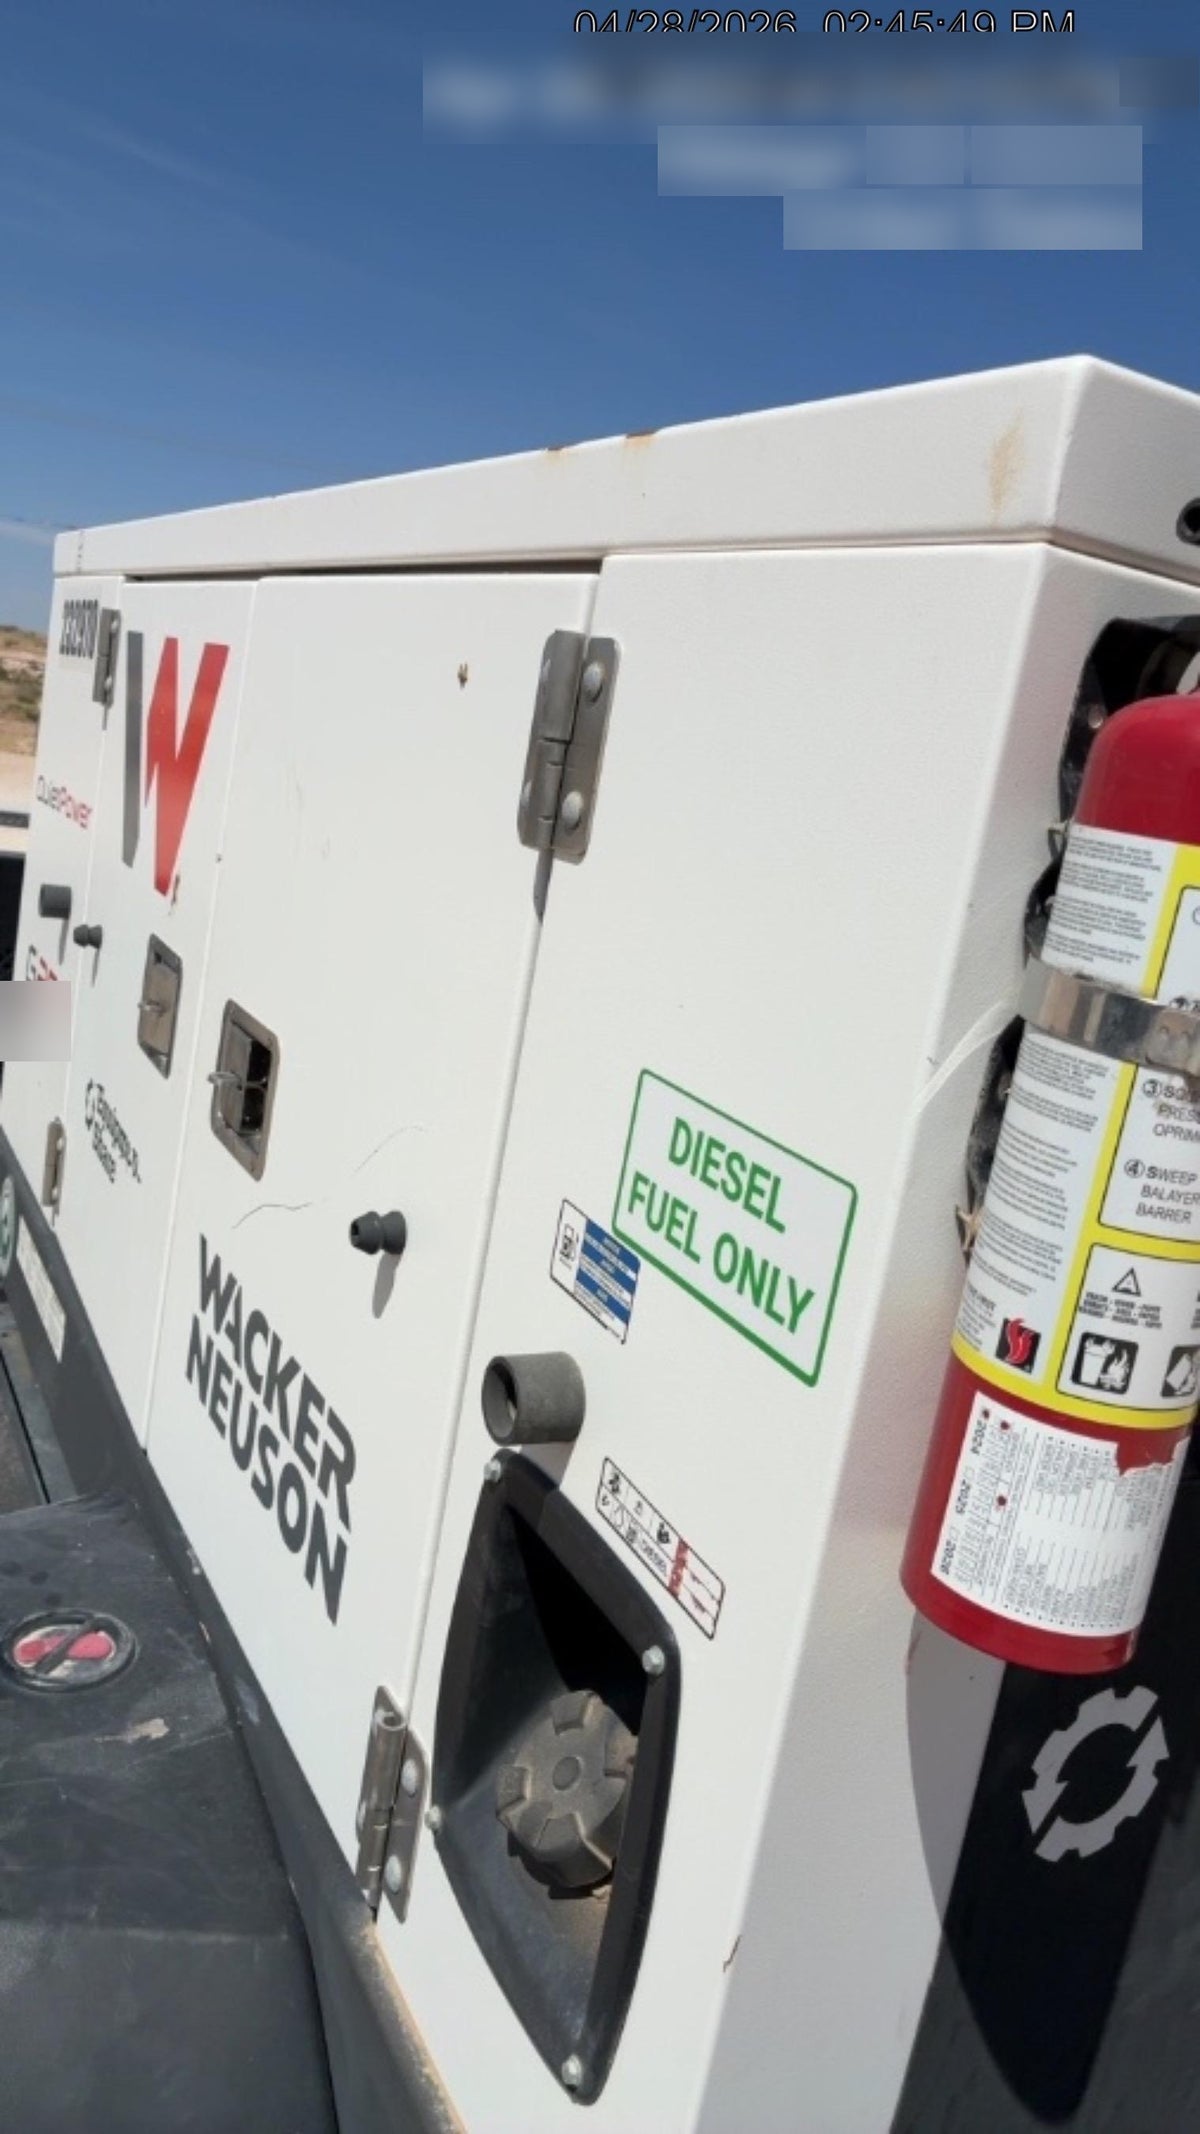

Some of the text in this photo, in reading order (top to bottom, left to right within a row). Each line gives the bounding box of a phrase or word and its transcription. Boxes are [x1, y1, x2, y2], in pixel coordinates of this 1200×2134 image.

[668, 1116, 786, 1235] DIESEL
[1135, 1202, 1192, 1224] BARRER
[1146, 1166, 1198, 1186] SWEEP
[627, 1170, 701, 1265] FUEL
[713, 1232, 815, 1334] ONLY
[199, 1233, 356, 1533] WACKER
[186, 1313, 348, 1627] NEUSON
